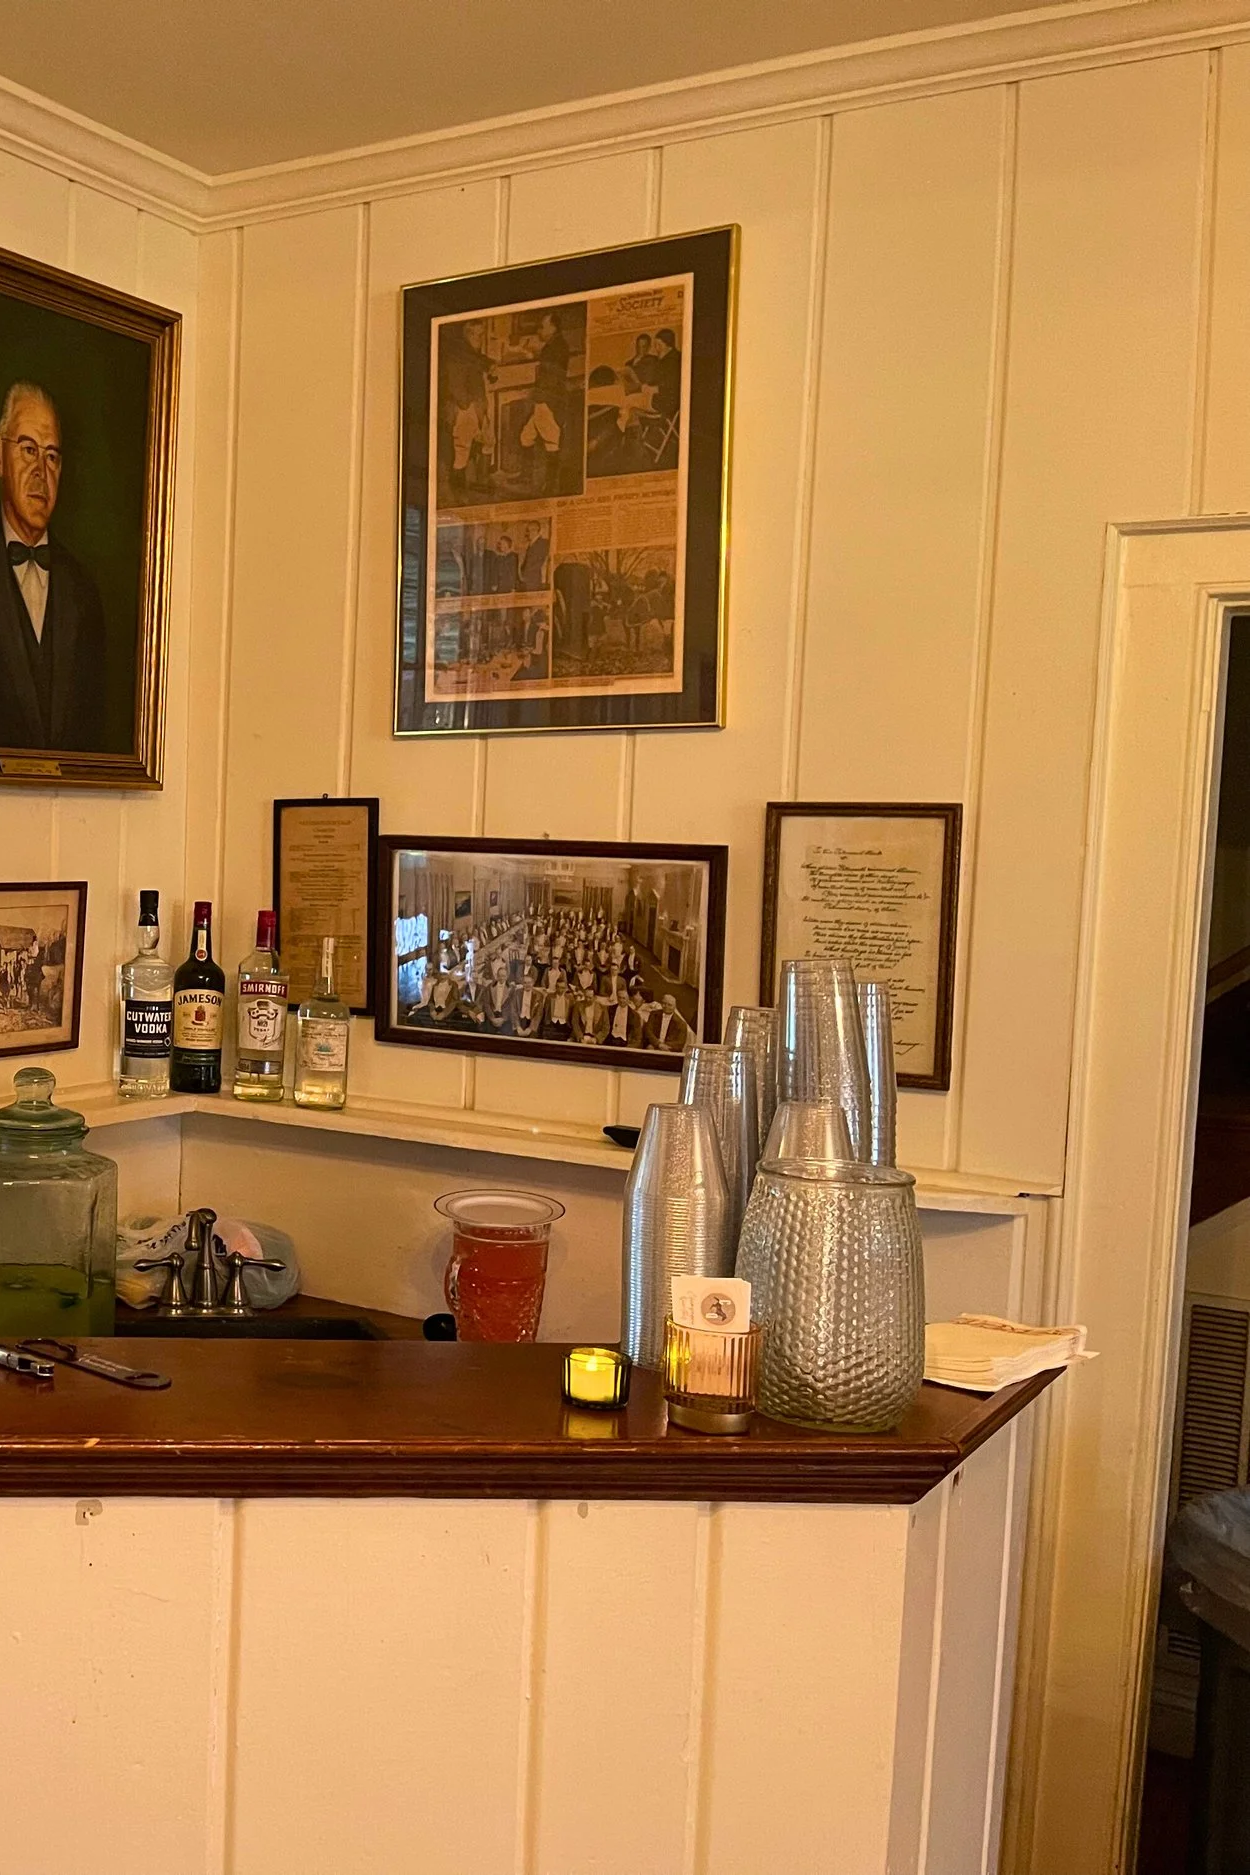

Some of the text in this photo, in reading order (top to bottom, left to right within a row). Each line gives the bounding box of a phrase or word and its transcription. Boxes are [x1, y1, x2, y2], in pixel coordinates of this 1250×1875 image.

[242, 983, 285, 996] SMIRNOFF
[177, 994, 223, 1007] JAMESON
[134, 1023, 168, 1034] VODKA
